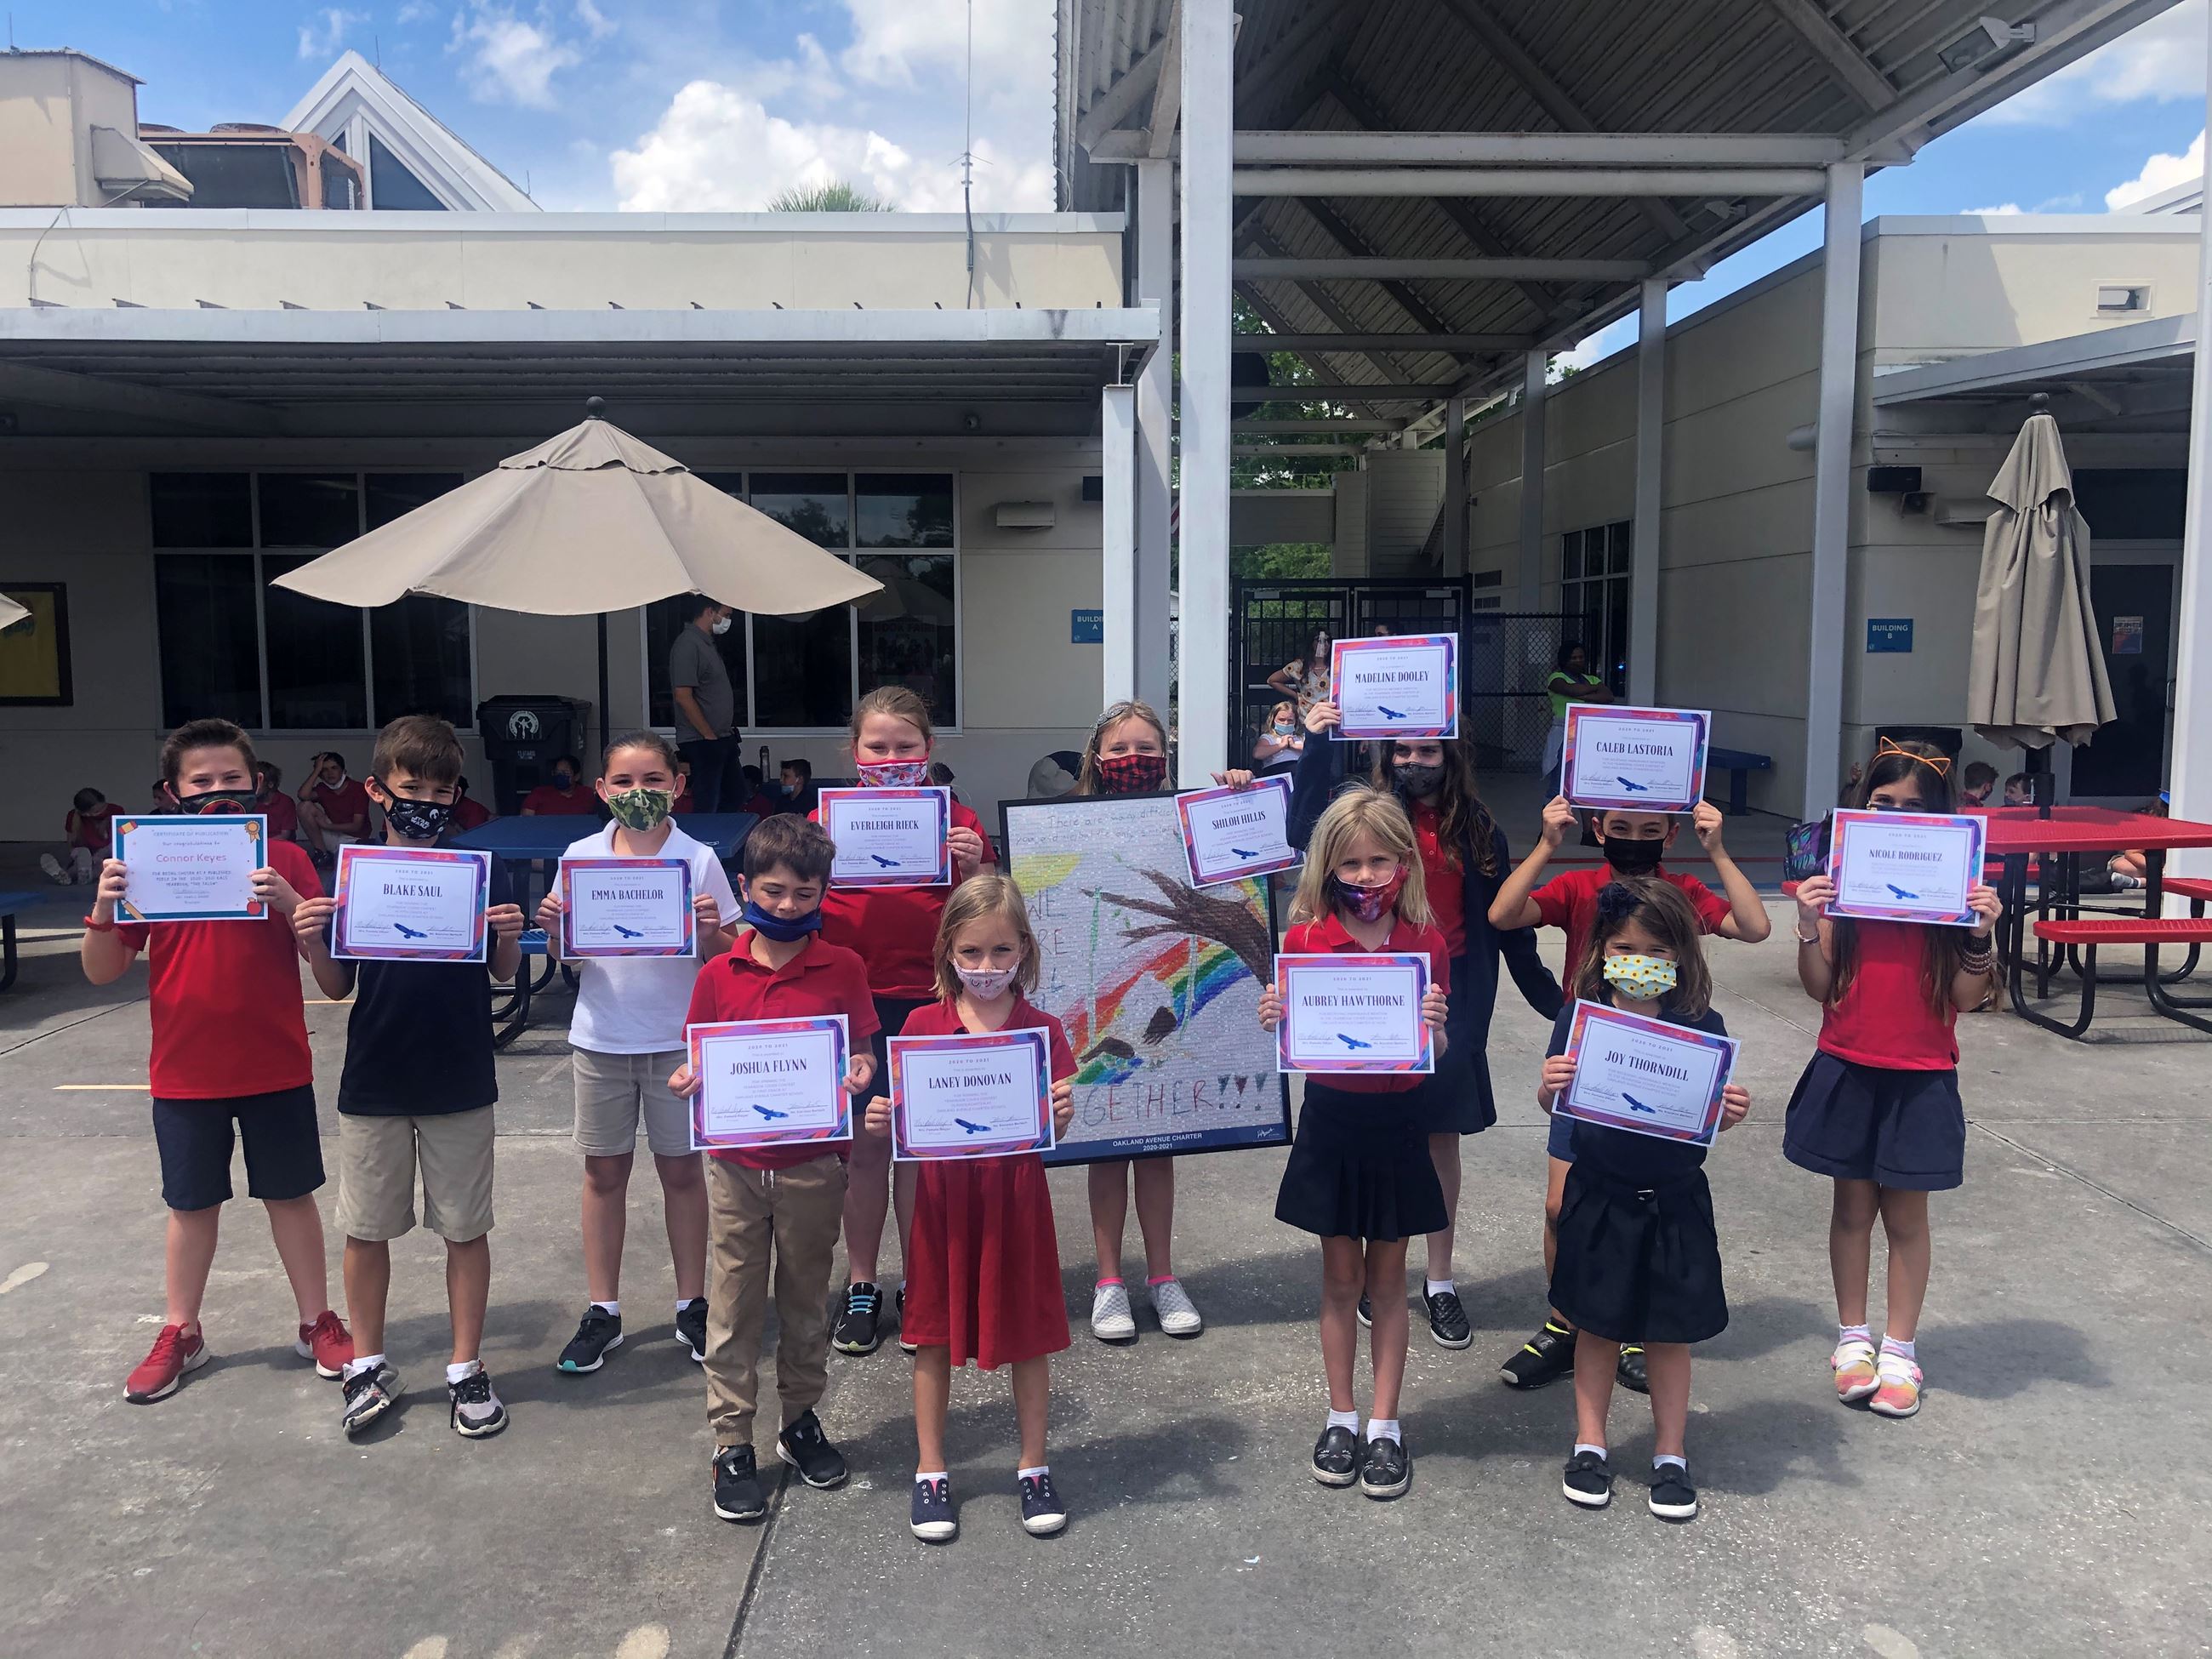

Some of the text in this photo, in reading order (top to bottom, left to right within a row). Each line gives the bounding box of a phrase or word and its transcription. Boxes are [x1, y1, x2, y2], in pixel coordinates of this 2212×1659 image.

[1355, 670, 1430, 683] MADELINE DOOLEY
[1596, 741, 1673, 757] CALEB LASTORIA
[851, 820, 920, 831] EVERLEIGH RIECK
[1047, 815, 1079, 829] There
[1211, 816, 1240, 830] SHILOH
[1241, 811, 1266, 824] HILLIS
[157, 853, 227, 864] Connor Keyes
[1869, 849, 1943, 863] NICOLE RODRIGUEZ
[383, 883, 443, 898] BLAKE SAUL
[591, 890, 664, 901] EMMA BACHELOR
[1037, 929, 1068, 955] RE
[1303, 995, 1405, 1006] AUBREY HAWTHORNE
[730, 1058, 807, 1075] JOSHUA FLYNN
[1605, 1051, 1628, 1065] JOY
[1628, 1055, 1689, 1082] THORNDILL
[929, 1073, 1012, 1089] LANEY DONOVAN
[1083, 1072, 1268, 1126] GETHER!!!
[1113, 1132, 1203, 1148] OAKLAND AVENUE CHARTER
[1143, 1143, 1173, 1152] 2020-2021
